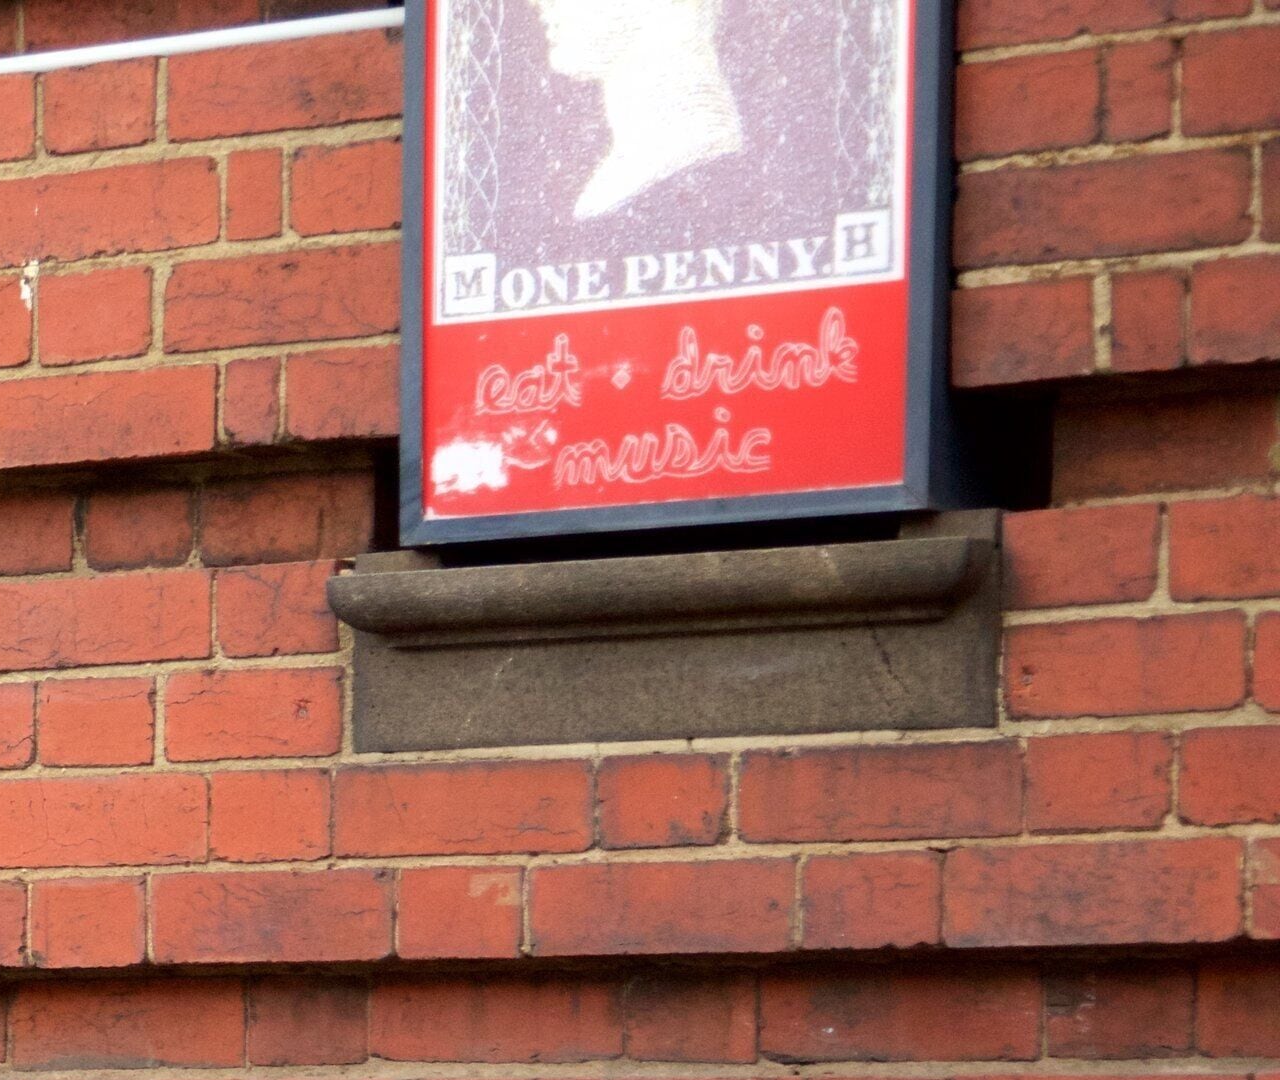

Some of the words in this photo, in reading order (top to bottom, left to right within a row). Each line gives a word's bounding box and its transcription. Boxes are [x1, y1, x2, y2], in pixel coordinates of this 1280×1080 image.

[501, 260, 612, 308] ONE
[474, 333, 582, 415] eat
[660, 306, 860, 400] drink
[553, 407, 772, 485] music
